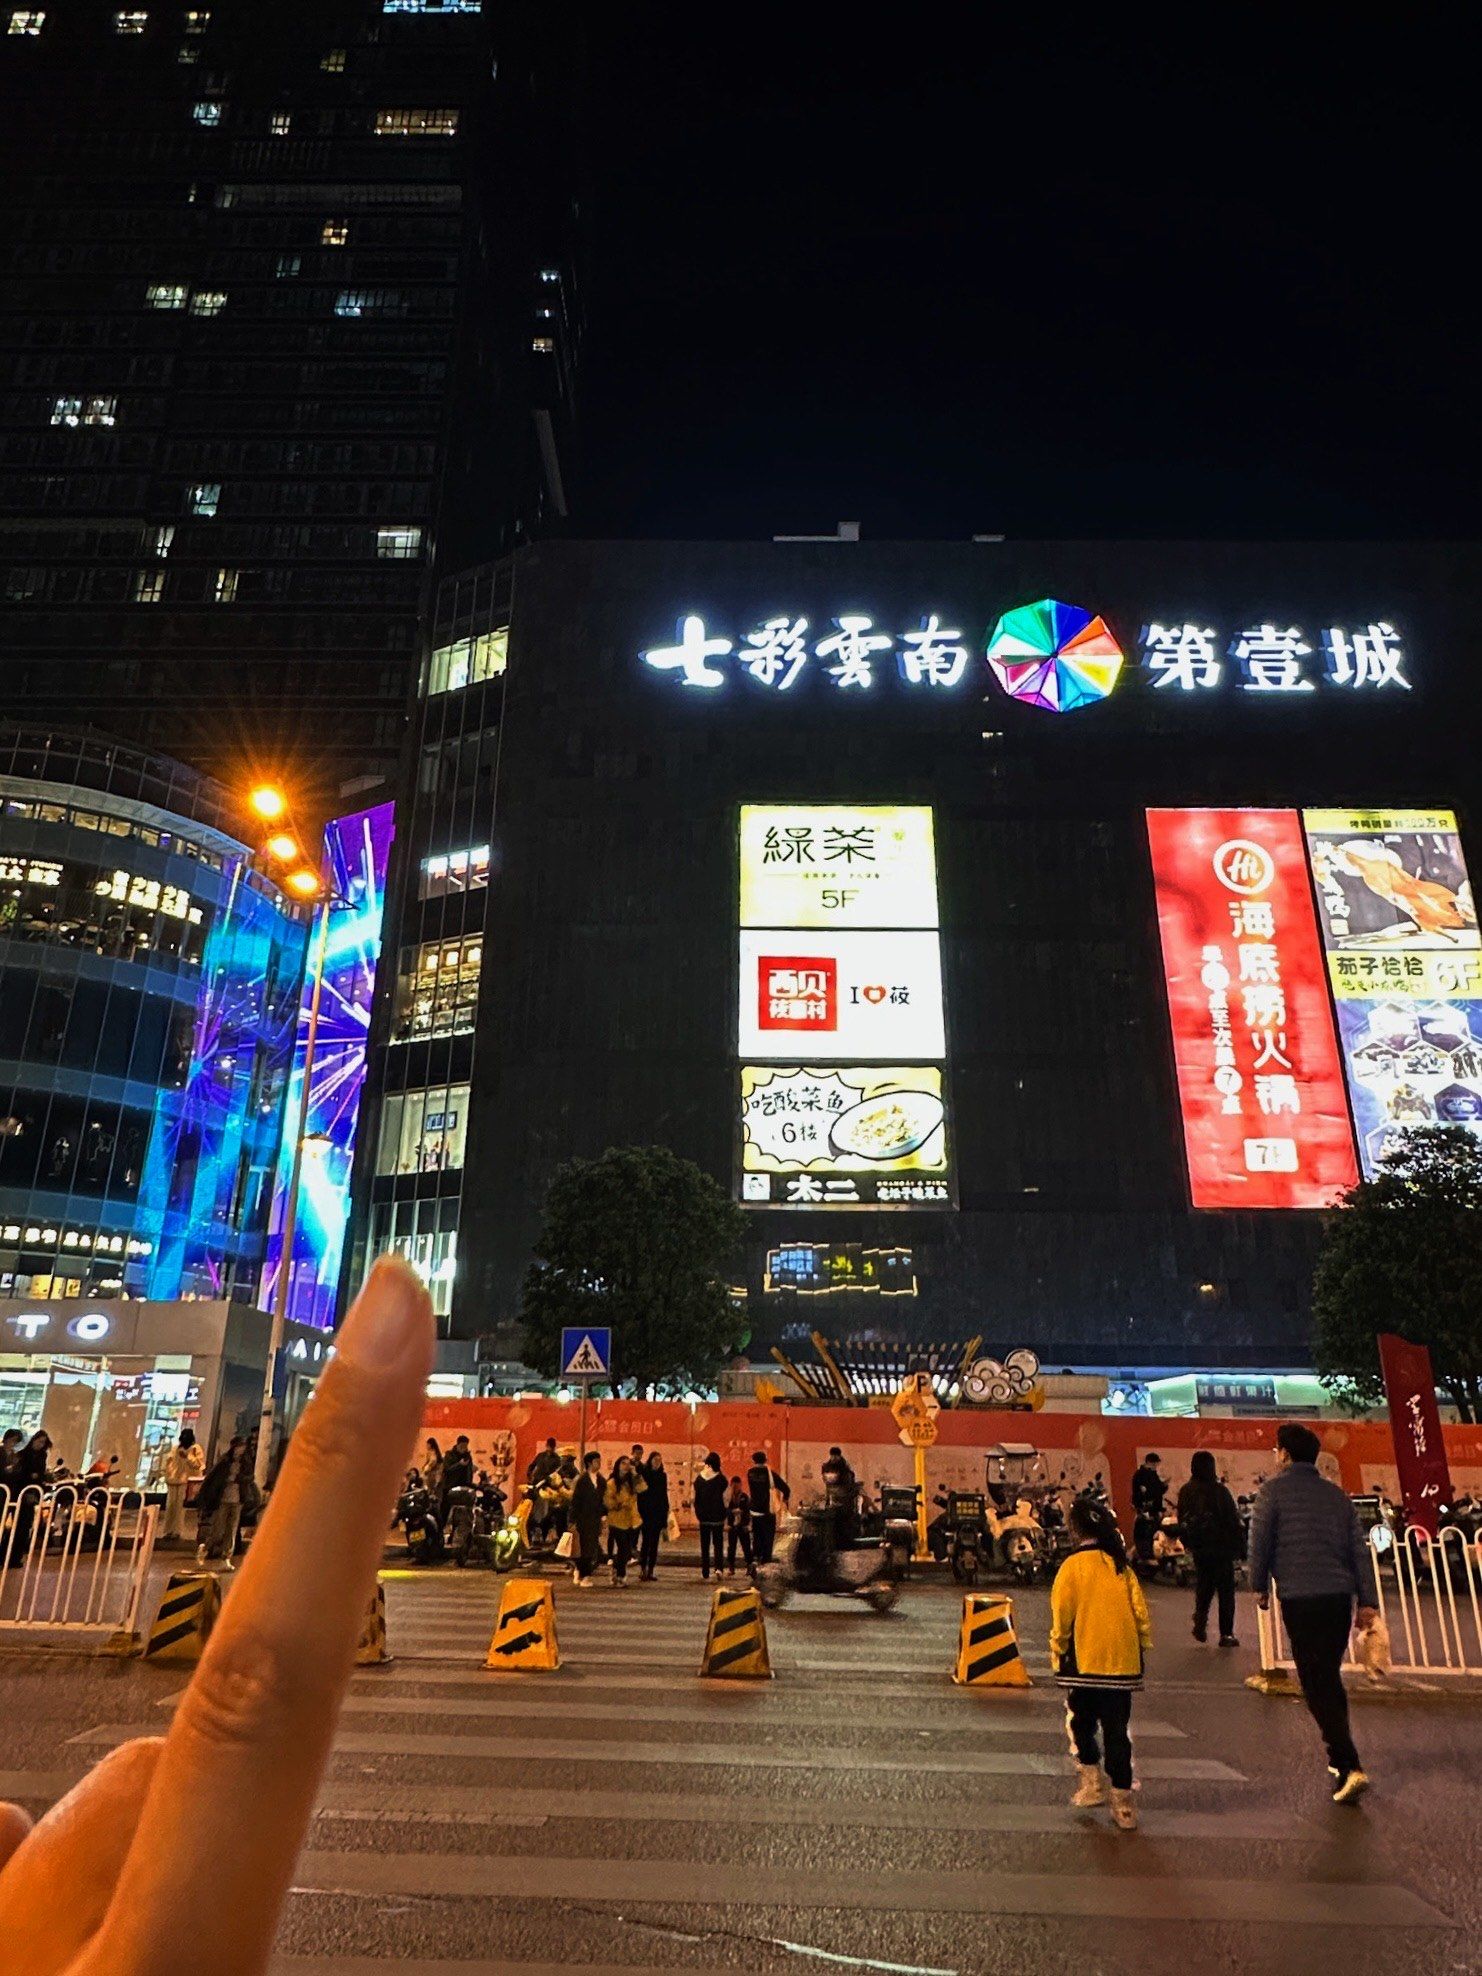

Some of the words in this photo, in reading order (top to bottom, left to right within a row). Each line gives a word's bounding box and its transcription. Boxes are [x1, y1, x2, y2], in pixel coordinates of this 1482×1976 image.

[645, 614, 967, 691] 七彩雲南
[1143, 621, 1413, 693] 第壹城
[822, 890, 860, 909] 5F
[1336, 956, 1424, 976] 茄子恰恰
[768, 969, 827, 998] 西贝
[850, 986, 860, 1004] I
[1229, 901, 1302, 1116] 海底捞火锅
[751, 1086, 846, 1116] 吃酸菜鱼
